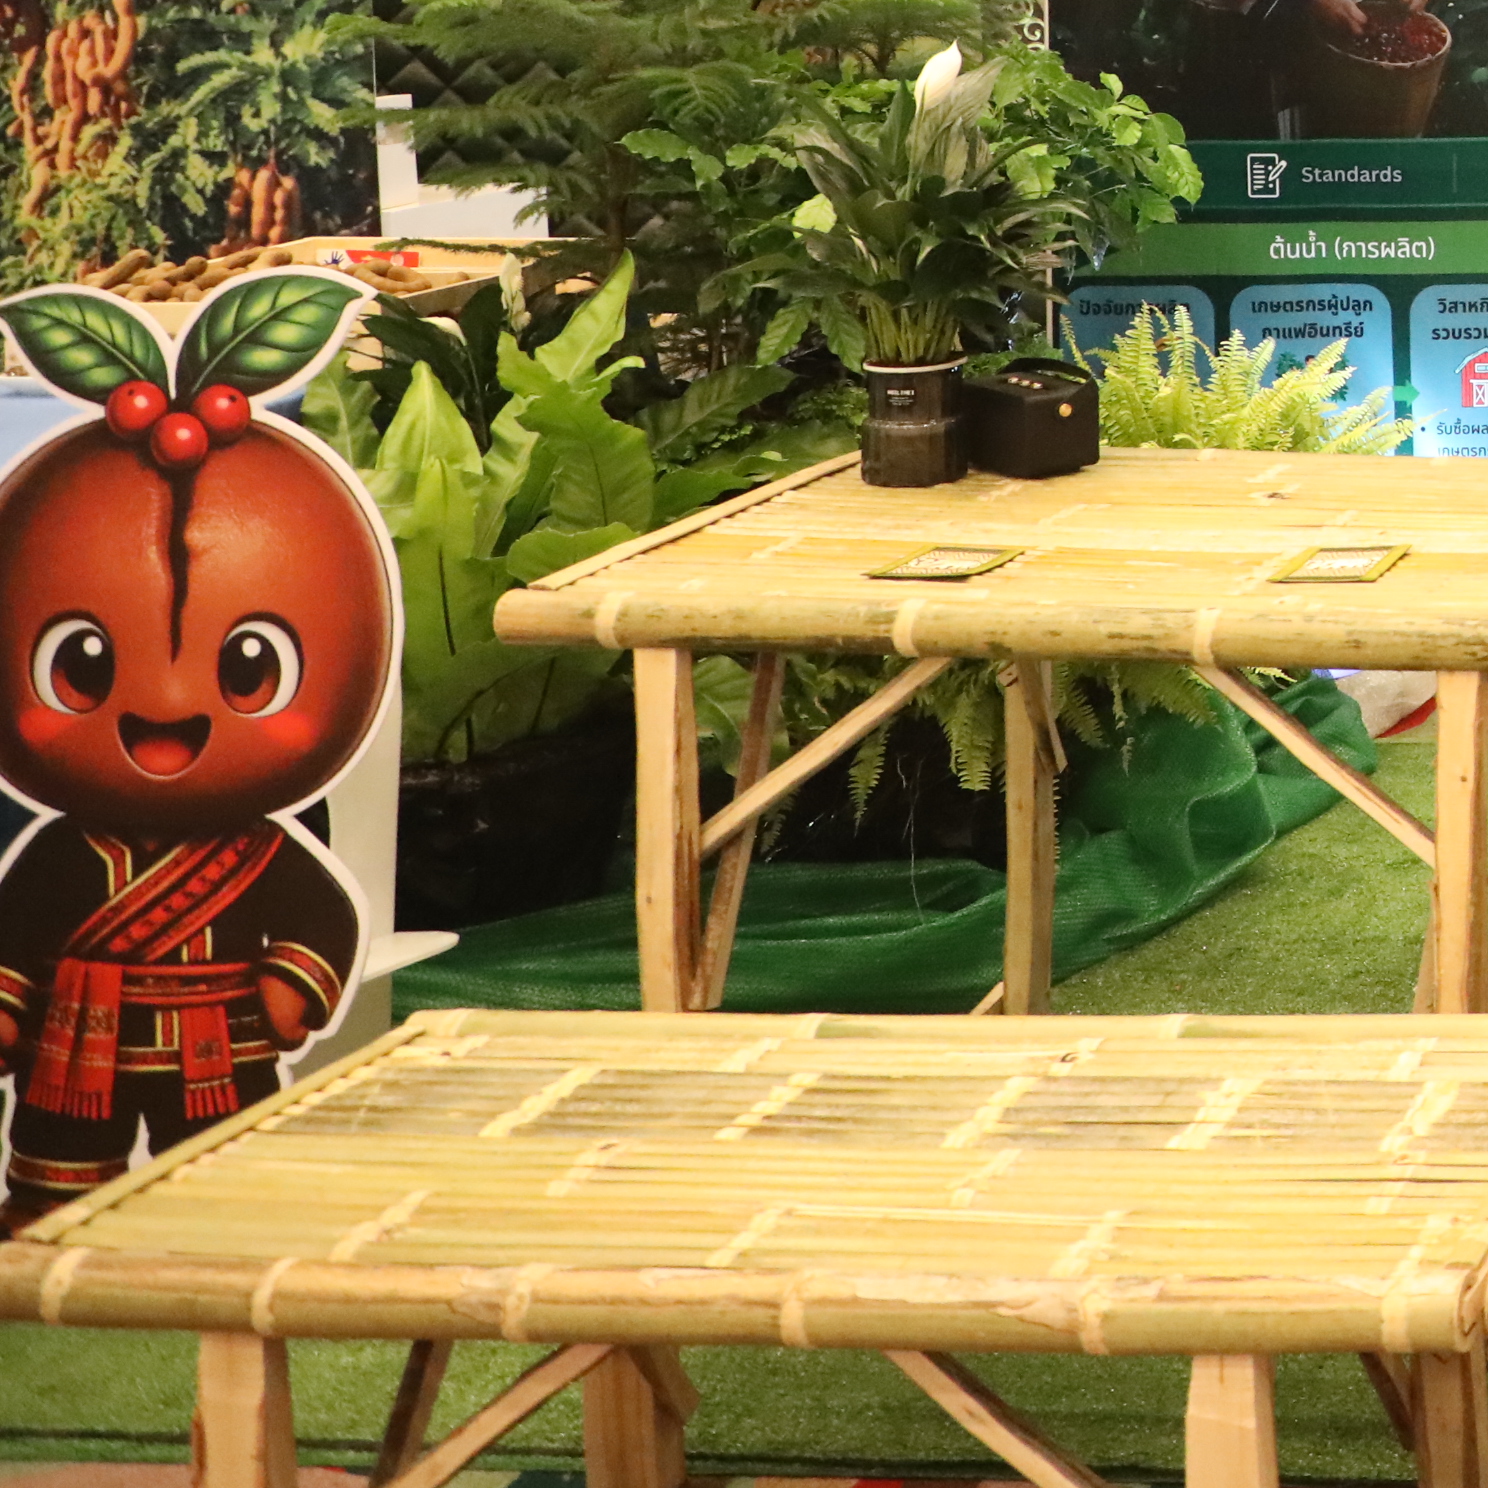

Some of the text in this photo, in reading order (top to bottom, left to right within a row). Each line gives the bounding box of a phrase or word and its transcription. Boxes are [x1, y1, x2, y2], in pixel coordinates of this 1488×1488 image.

[1301, 164, 1402, 185] Standards
[1269, 230, 1436, 262] ต้นน้ำ (การผลิต)
[1250, 295, 1374, 324] เกษตรกรผู้ปลูก
